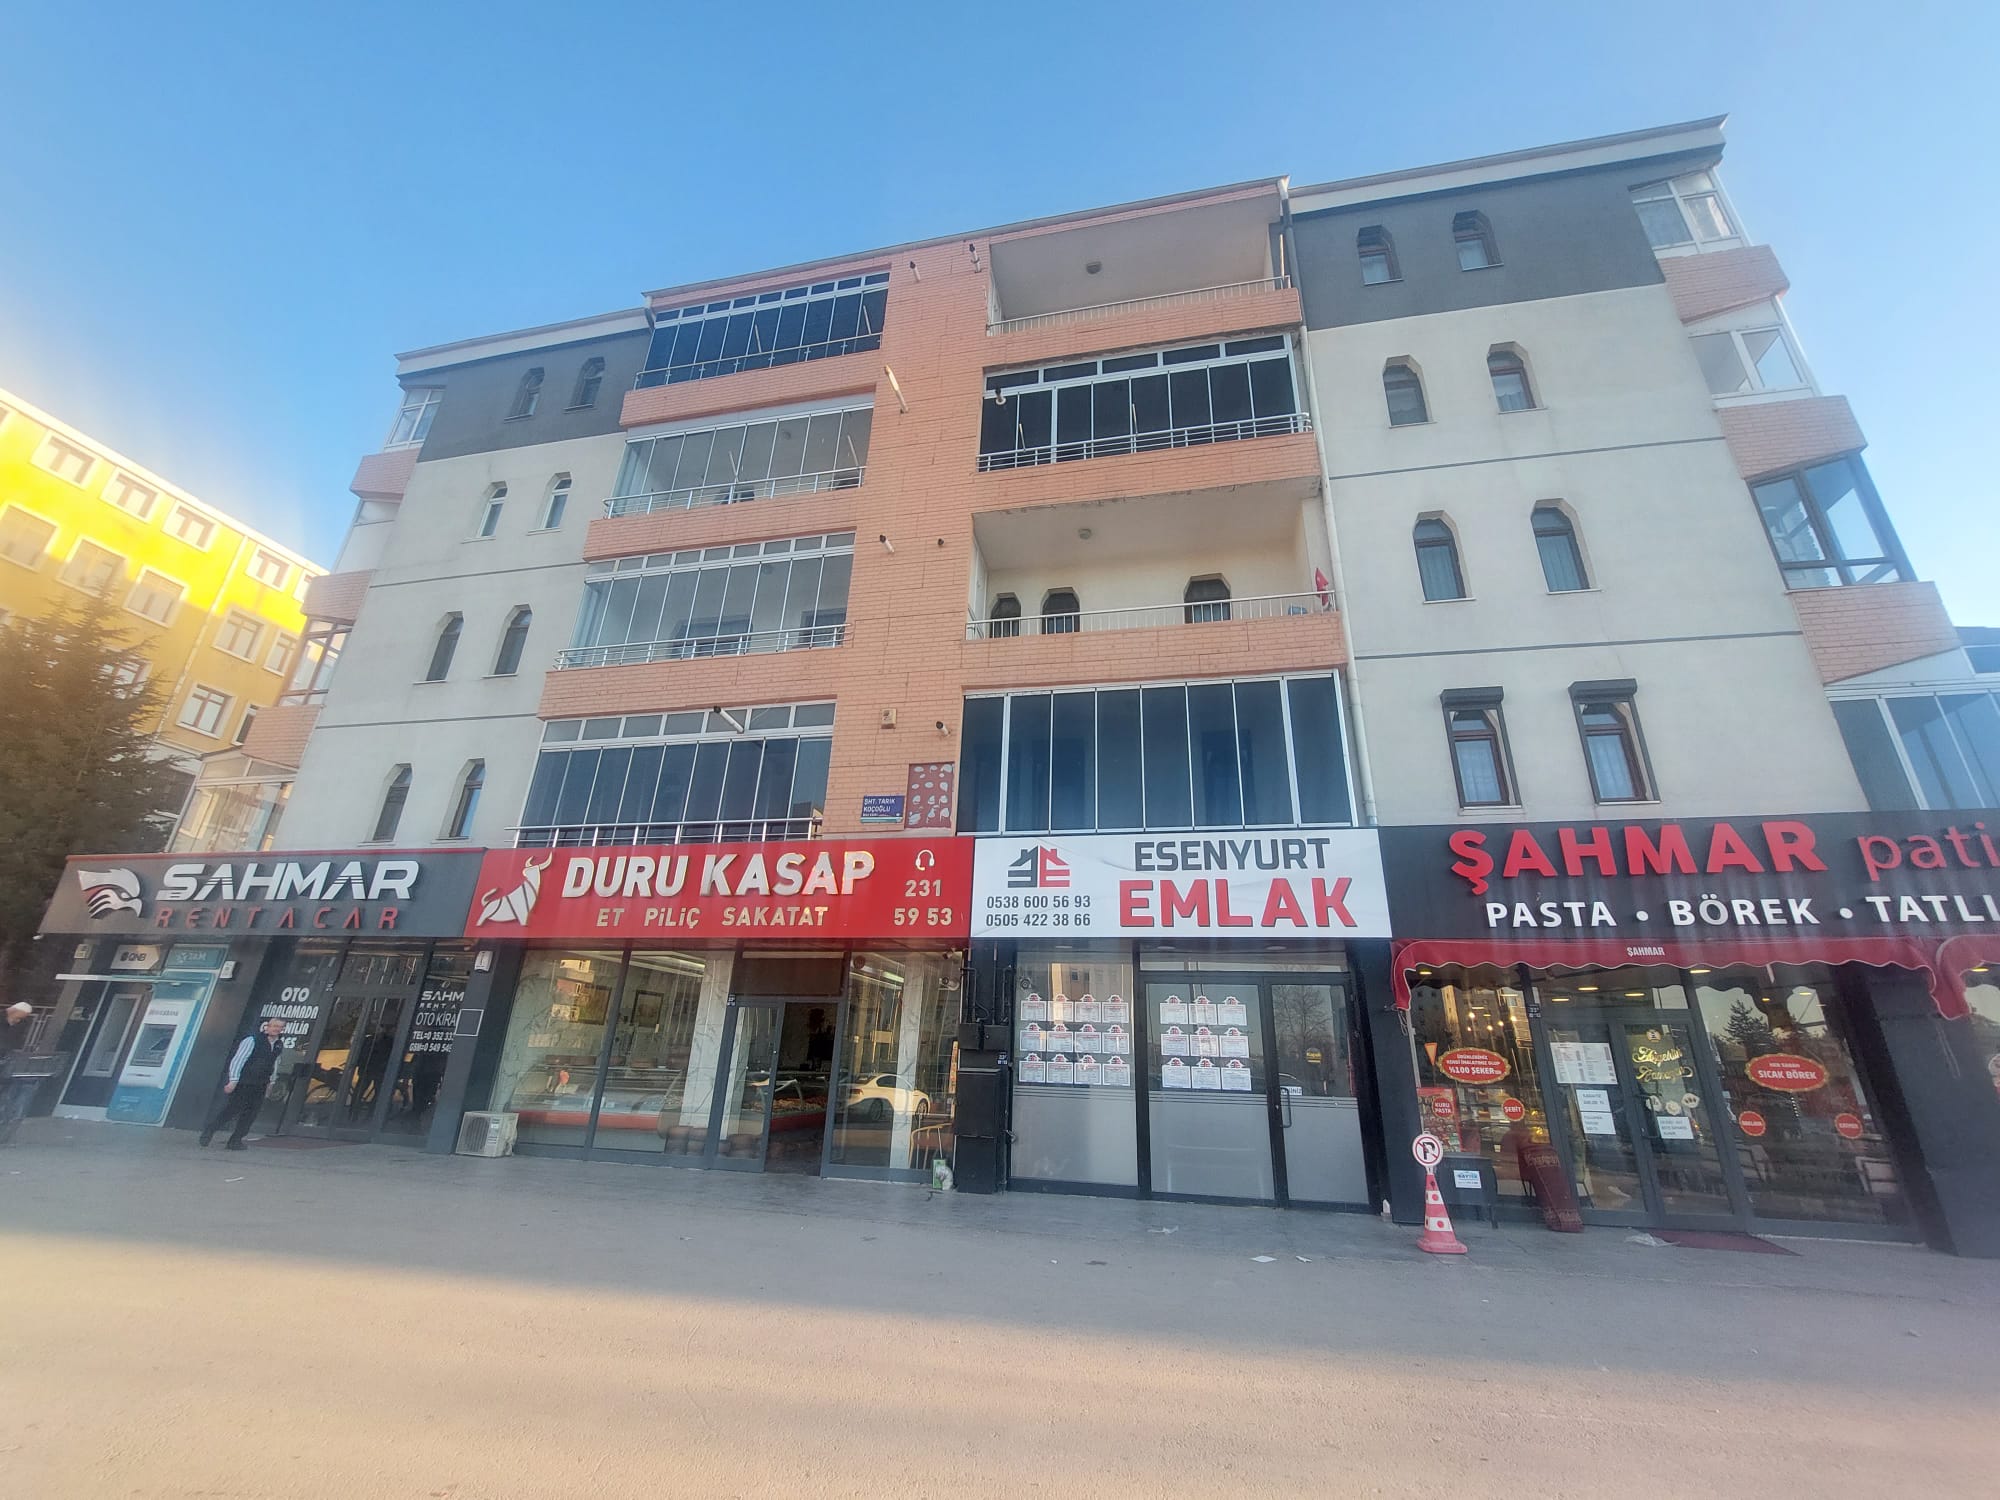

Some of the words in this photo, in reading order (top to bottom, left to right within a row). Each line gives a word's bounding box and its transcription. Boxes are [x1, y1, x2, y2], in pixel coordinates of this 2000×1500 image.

[1134, 838, 1330, 871] ESENYURT
[1449, 820, 1828, 895] ŞAHMAR
[155, 860, 420, 900] SAHMAR
[561, 855, 689, 898] DURU
[700, 850, 875, 896] KASAP
[904, 879, 941, 897] 231
[987, 896, 1019, 908] 0538
[1023, 895, 1048, 908] 600
[1053, 895, 1069, 908] 56
[1074, 895, 1091, 908] 93
[1119, 878, 1358, 928] EMLAK
[1486, 901, 1617, 928] PASTA
[1668, 893, 1820, 926] BÖREK
[1865, 894, 2000, 922] TATLI
[596, 907, 625, 926] ET
[721, 905, 828, 926] SAKATAT
[893, 907, 919, 926] 59
[927, 907, 952, 926] 53
[986, 914, 1018, 926] 0505
[1023, 913, 1048, 926] 422
[1052, 913, 1069, 926] 38
[1074, 913, 1091, 926] 66
[281, 987, 310, 1002] OTO
[415, 1012, 435, 1025] OTO
[1758, 1070, 1785, 1079] SICAK
[1786, 1069, 1817, 1080] BÖREK
